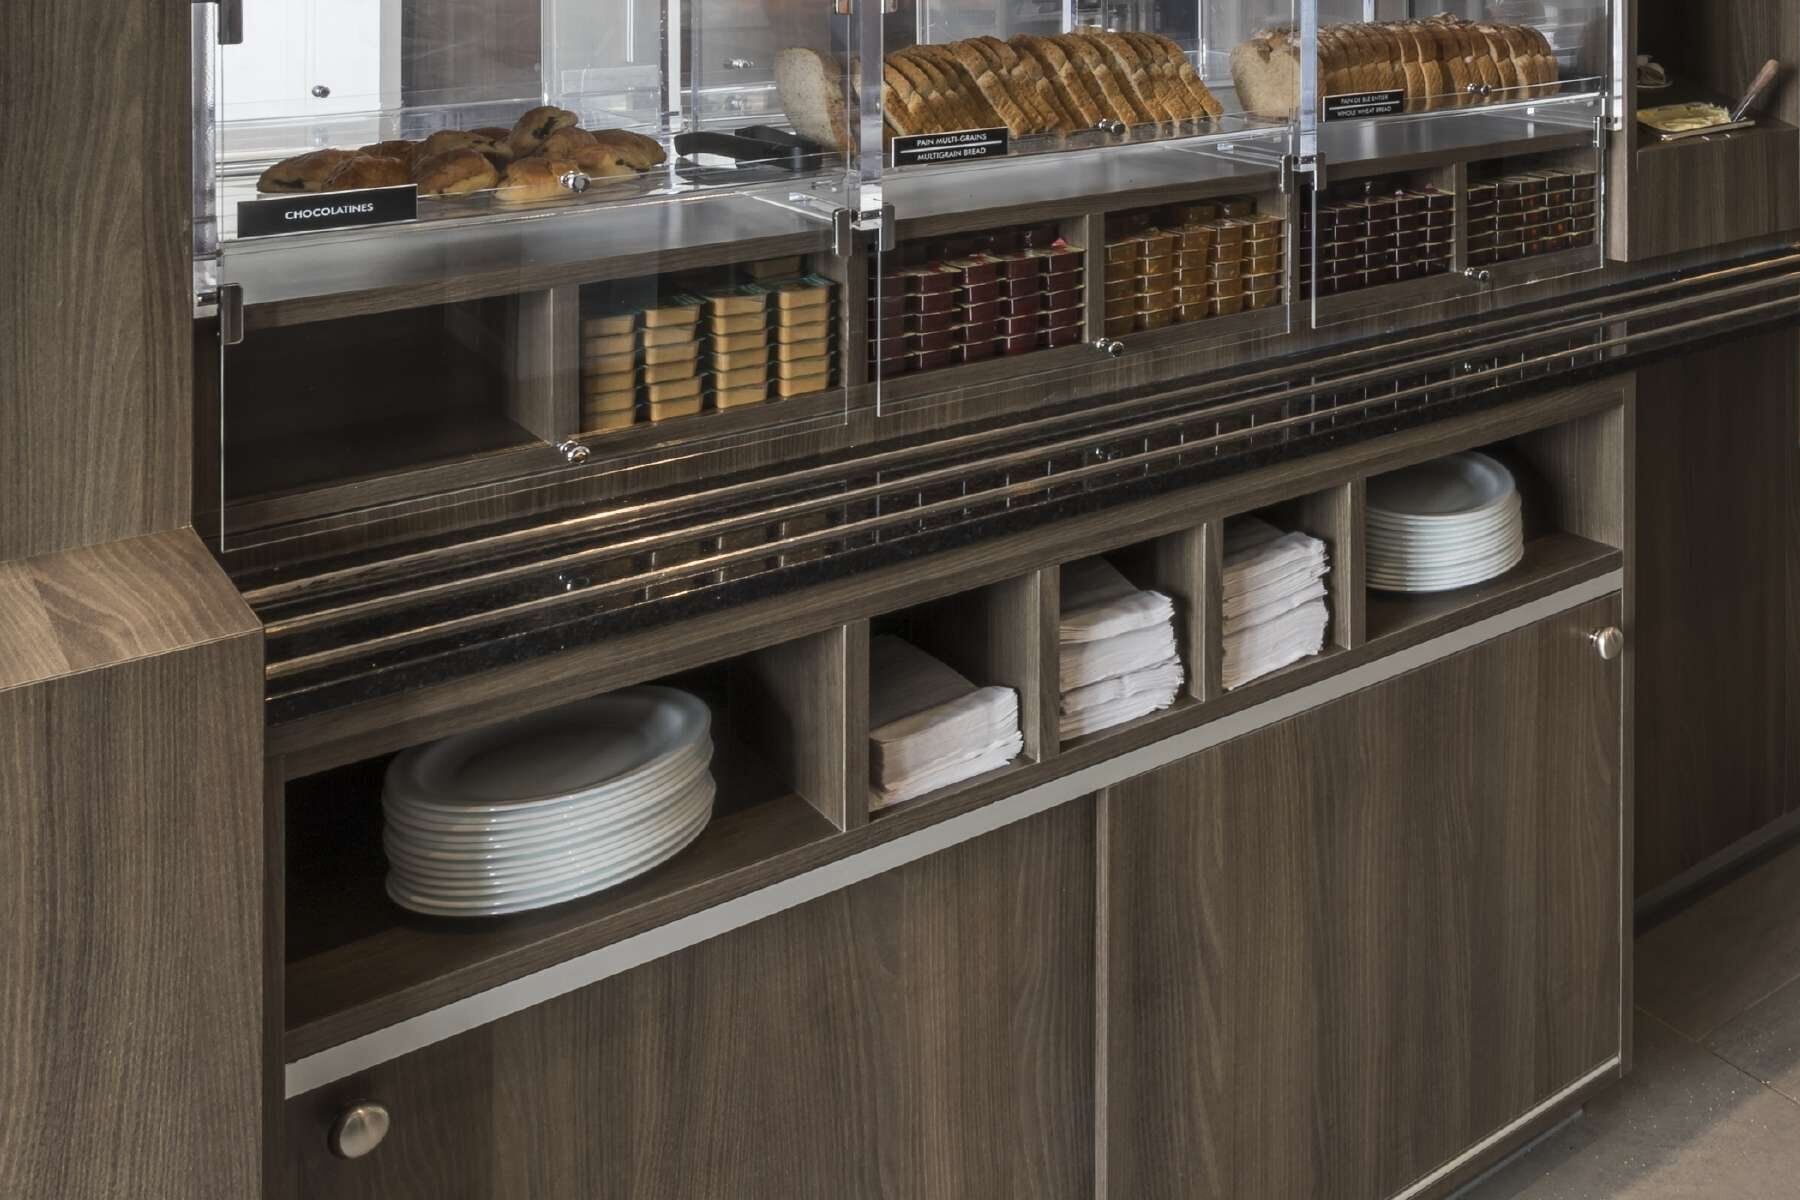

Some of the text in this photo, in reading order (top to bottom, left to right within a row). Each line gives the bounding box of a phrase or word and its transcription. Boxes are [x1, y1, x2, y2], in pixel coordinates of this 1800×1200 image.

[916, 133, 987, 147] PAIN MULTI-GRAINS
[917, 147, 986, 160] MULTIGRAIN BREAD
[284, 202, 374, 220] CHOCOLATINES
